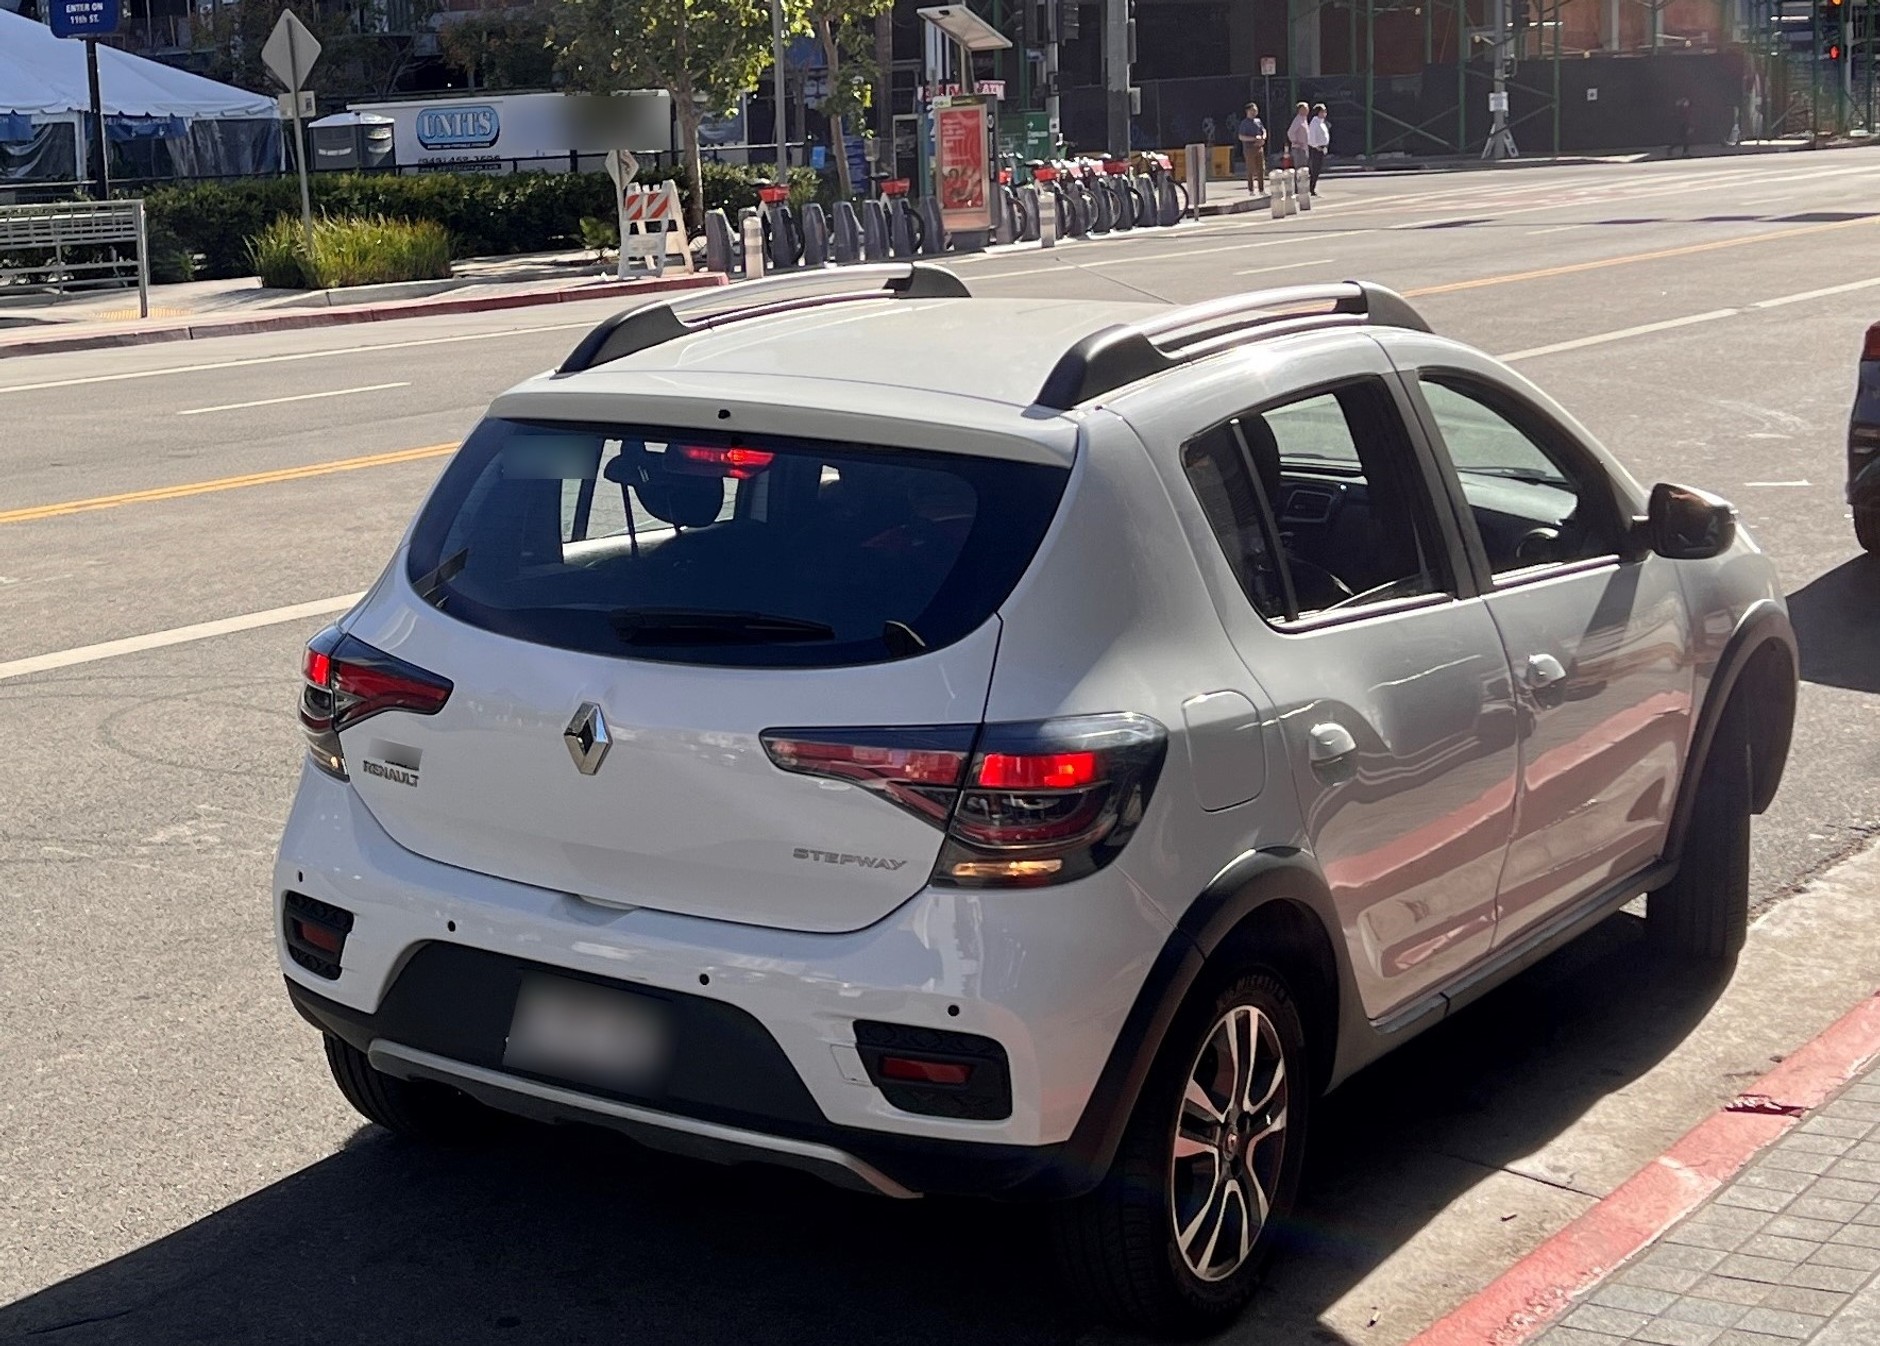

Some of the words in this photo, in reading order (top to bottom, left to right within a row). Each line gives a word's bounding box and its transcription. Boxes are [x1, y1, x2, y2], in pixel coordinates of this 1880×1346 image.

[66, 3, 90, 13] ENTER
[91, 2, 104, 11] ON
[422, 111, 492, 139] UNITS
[363, 760, 420, 788] RENAULT
[793, 847, 908, 871] STEPWAY
